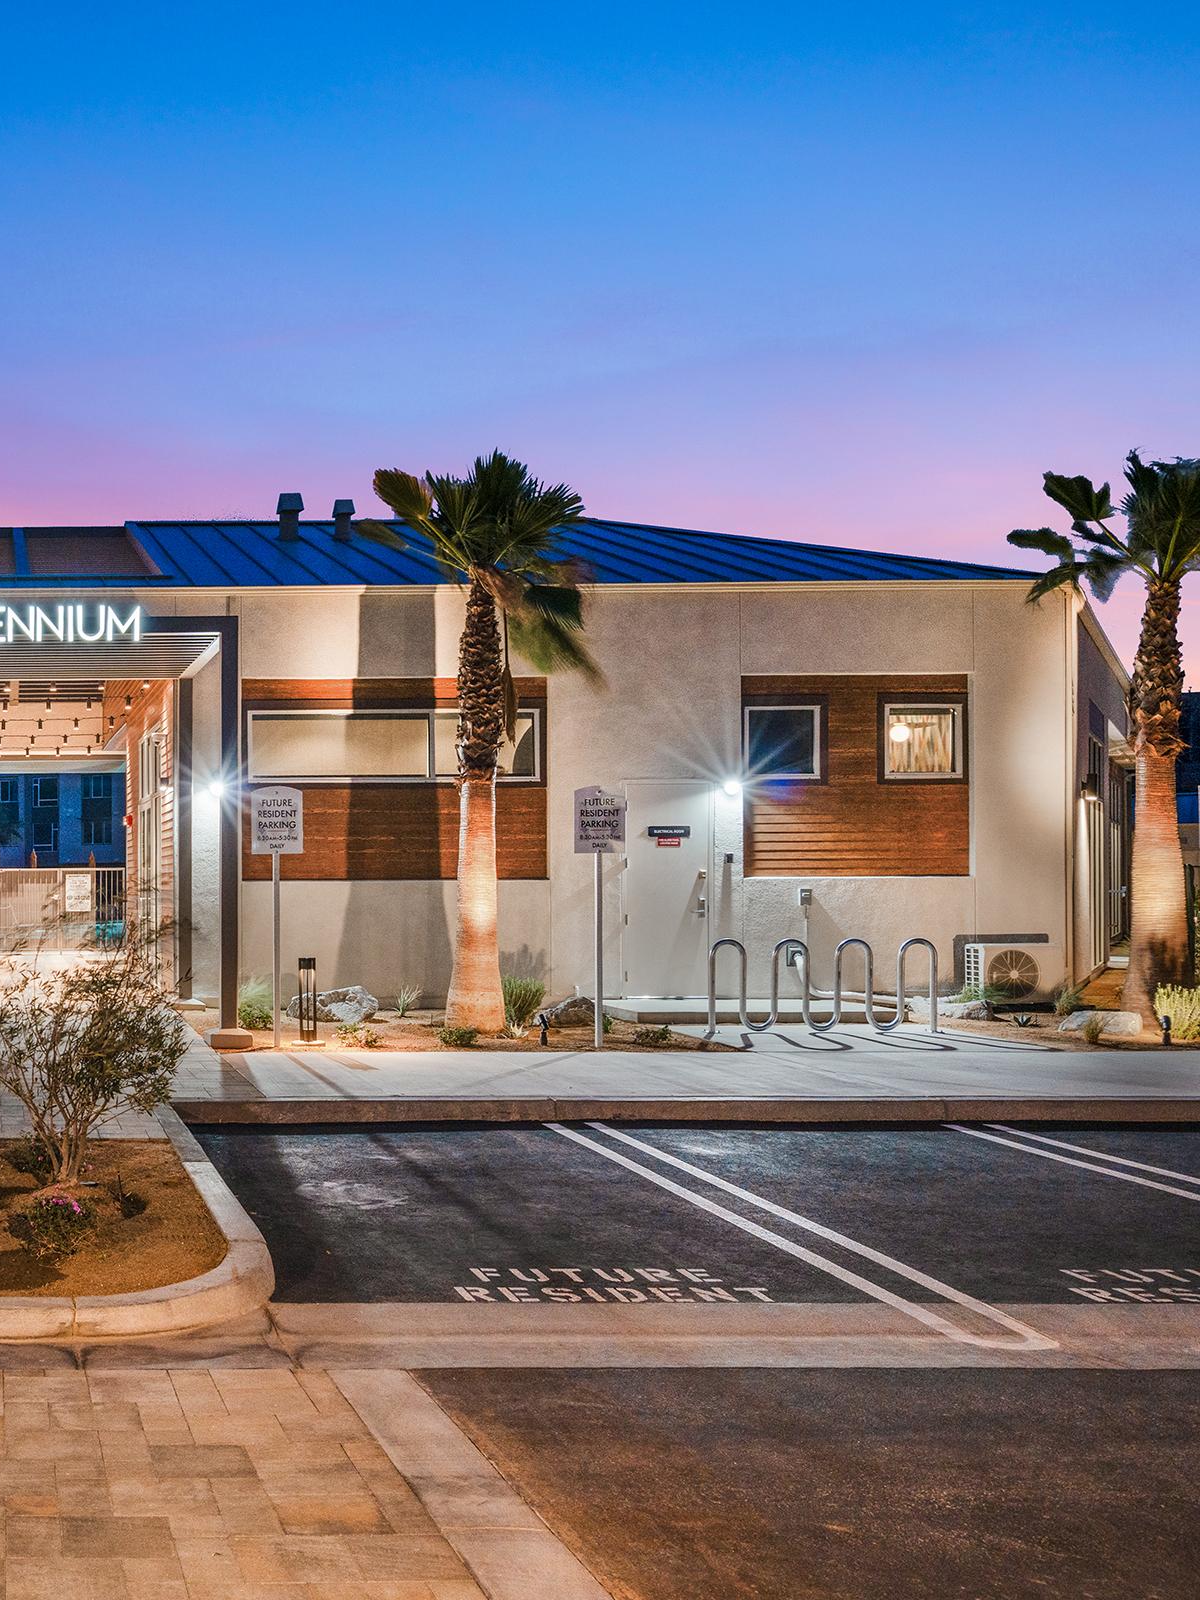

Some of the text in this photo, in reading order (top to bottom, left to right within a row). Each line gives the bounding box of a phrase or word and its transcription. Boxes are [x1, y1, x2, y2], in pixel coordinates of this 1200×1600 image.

[261, 799, 292, 807] FUTURE
[584, 798, 615, 806] FUTURE
[257, 810, 297, 818] RESIDENT
[580, 809, 620, 817] RESIDENT
[258, 821, 296, 829] PARKING
[581, 820, 619, 828] PARKING
[469, 1268, 723, 1282] FUTURE
[453, 1286, 775, 1302] RESIDENT
